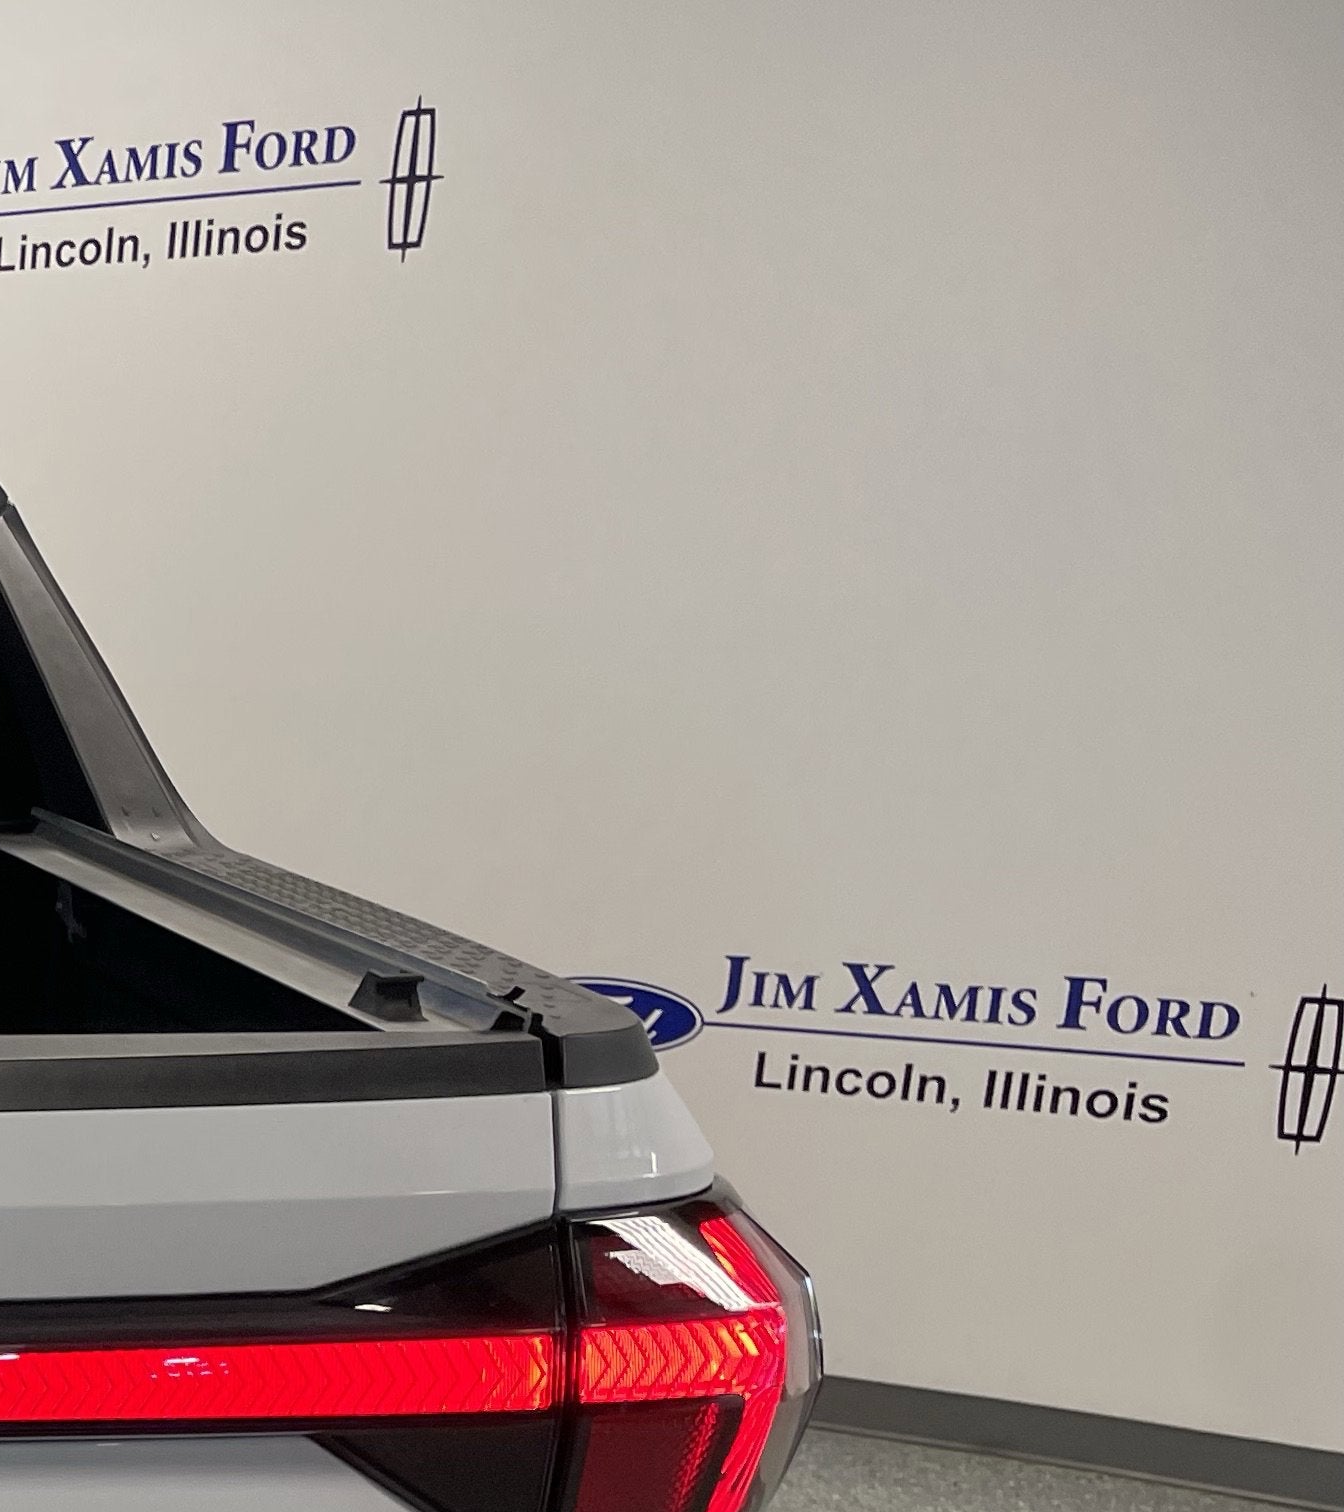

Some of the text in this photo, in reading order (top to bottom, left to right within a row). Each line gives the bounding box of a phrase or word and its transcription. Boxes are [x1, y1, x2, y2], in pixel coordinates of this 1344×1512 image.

[166, 212, 308, 260] Illinois
[754, 1051, 1169, 1124] Lincoln, Illinois
